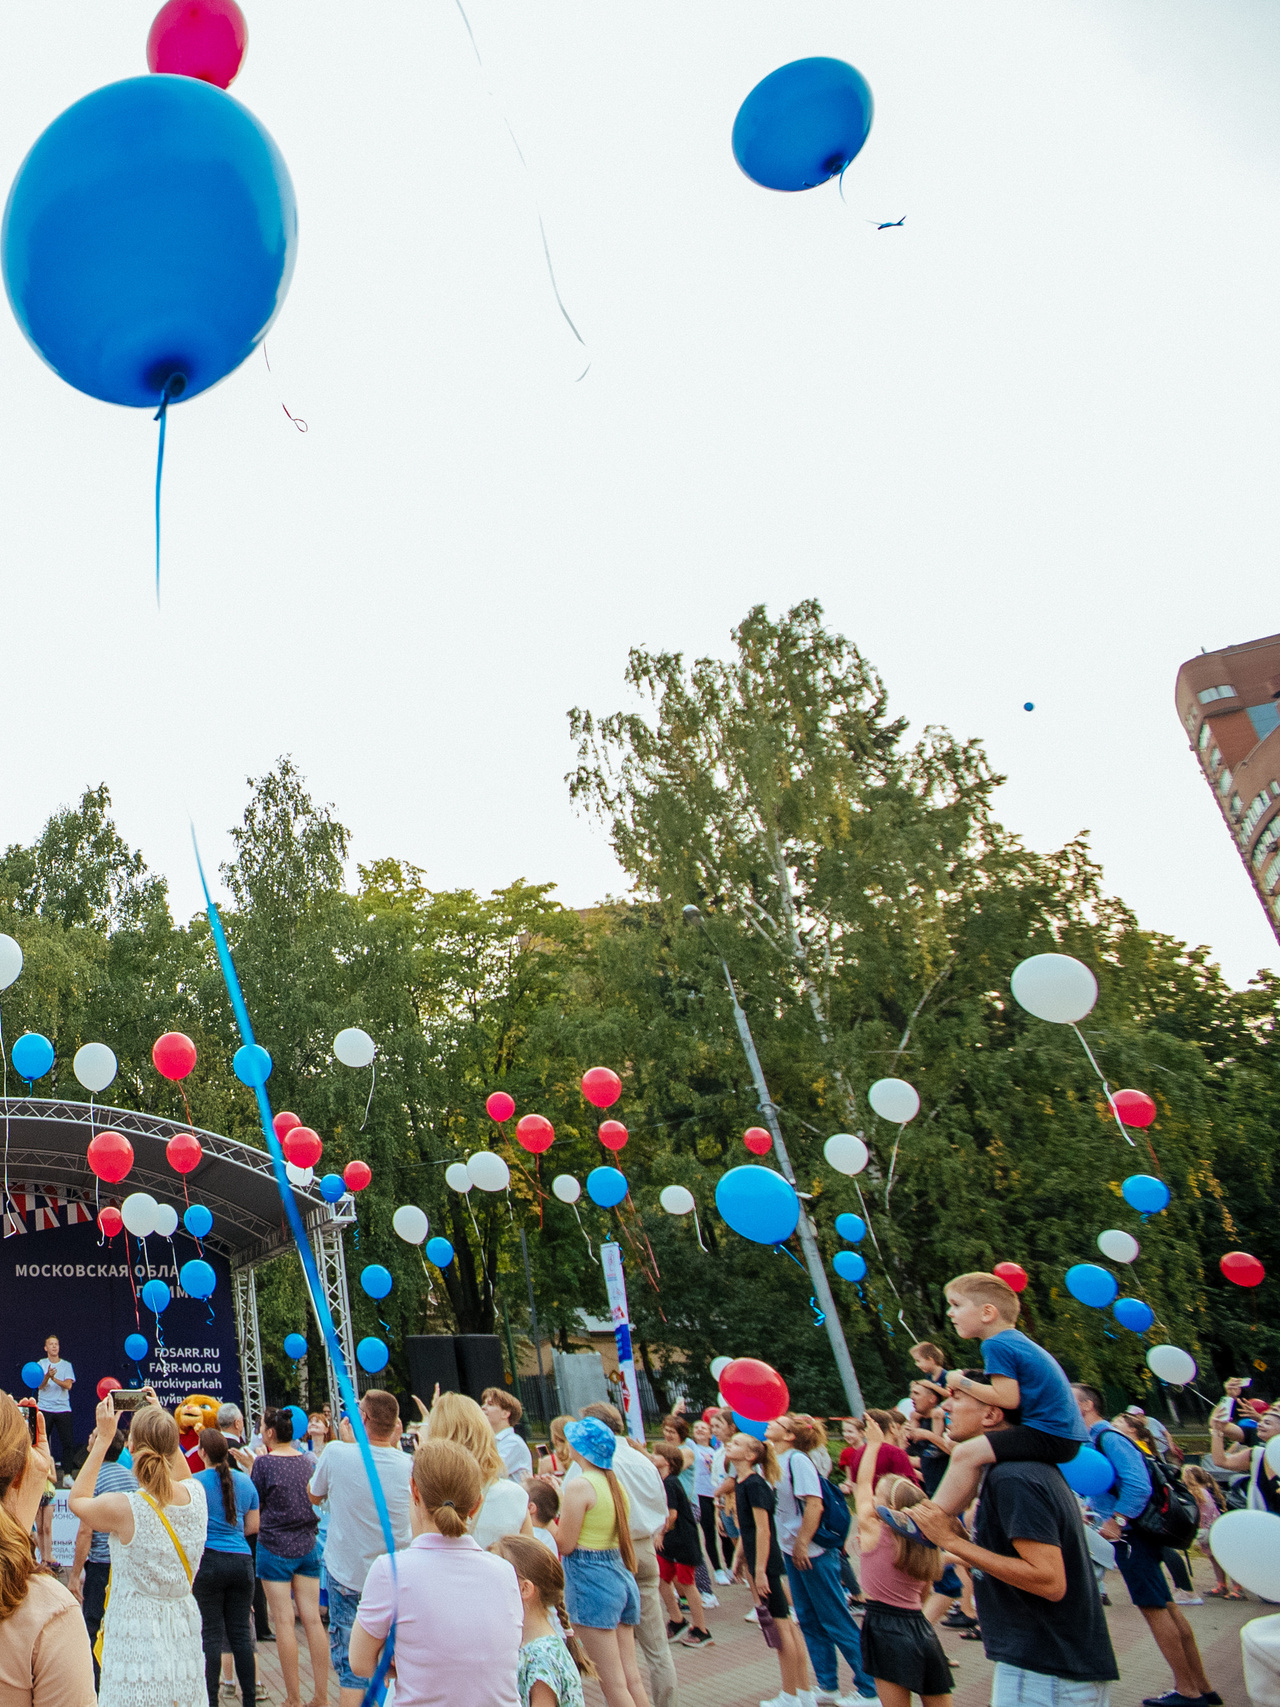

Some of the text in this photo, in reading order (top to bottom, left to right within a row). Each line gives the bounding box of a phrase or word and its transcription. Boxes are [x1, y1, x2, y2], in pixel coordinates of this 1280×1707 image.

[15, 1264, 183, 1277] МОСКОВСКАЯ ОБЛА
[154, 1347, 220, 1358] FDSARR.RU
[149, 1362, 221, 1373] FARR-MO.RU
[143, 1378, 222, 1391] #urokivparkah
